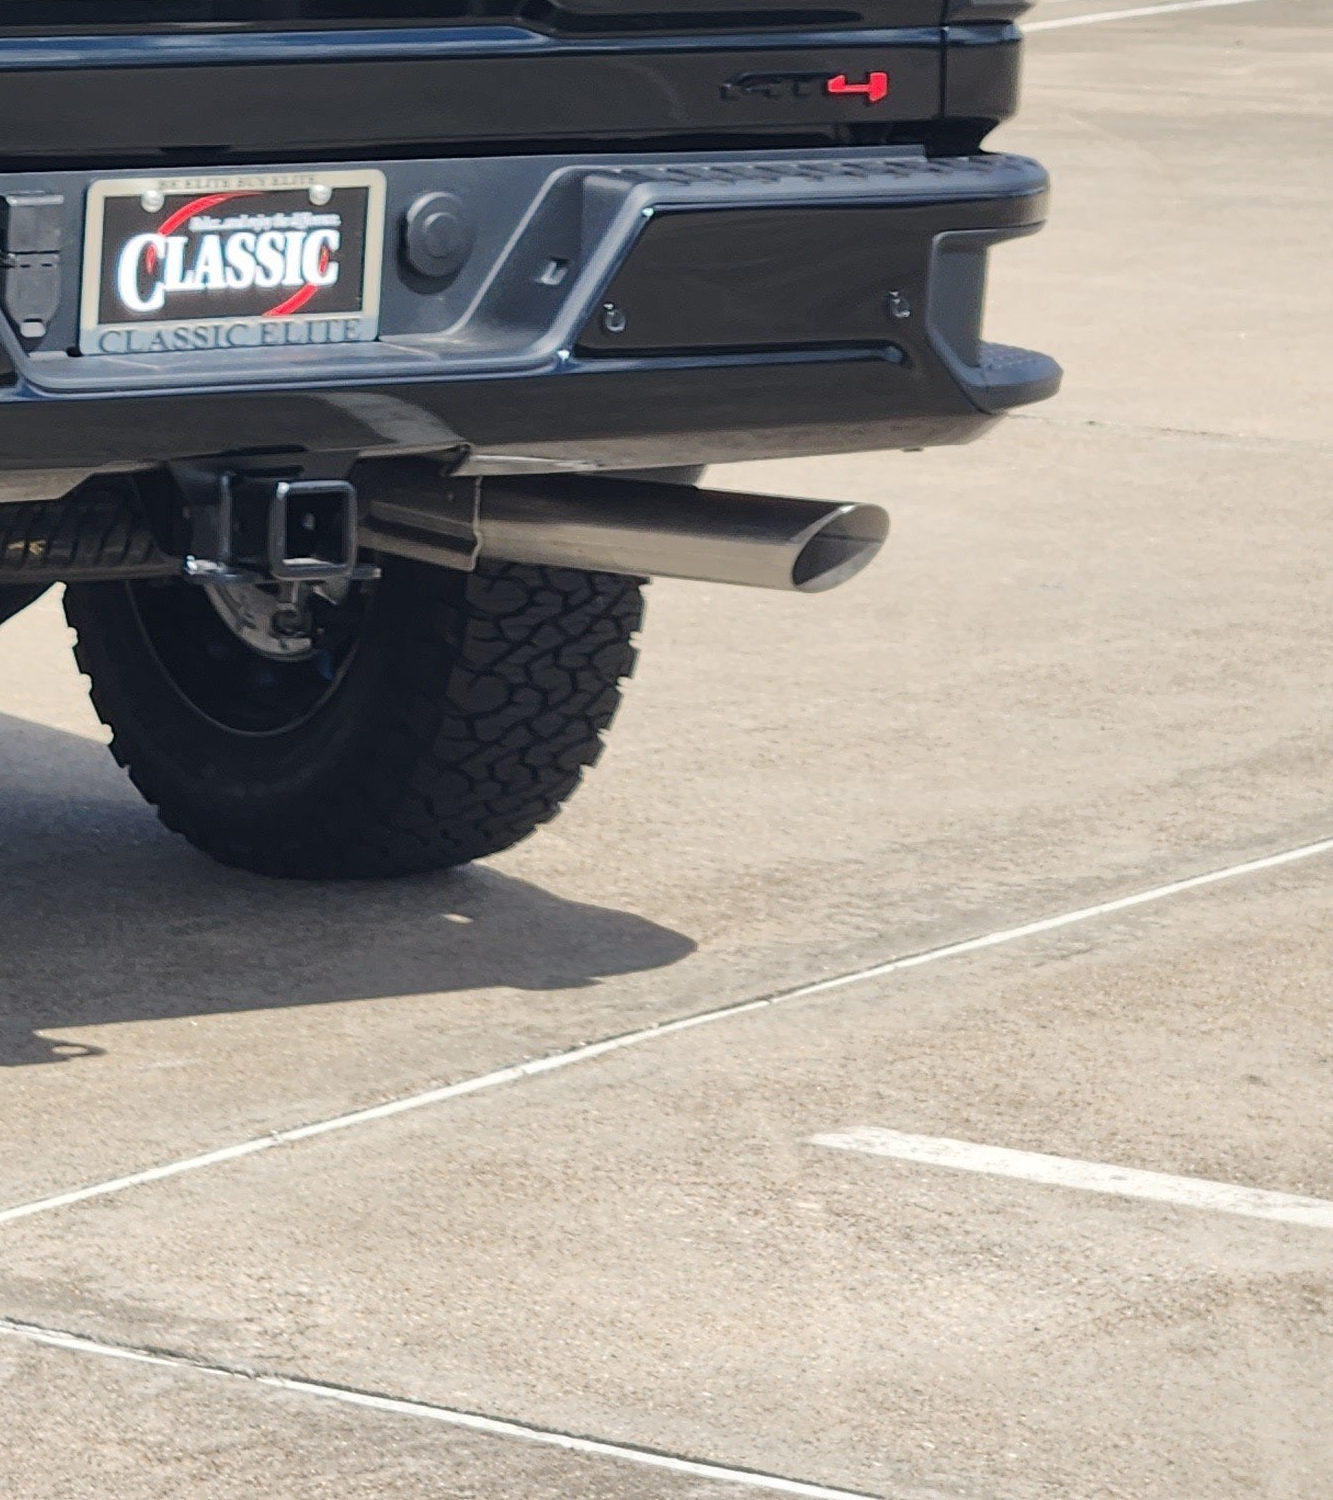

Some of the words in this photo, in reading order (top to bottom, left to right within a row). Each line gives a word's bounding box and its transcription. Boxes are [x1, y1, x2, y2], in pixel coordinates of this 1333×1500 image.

[116, 228, 341, 313] CLASSIC
[98, 325, 249, 354] CLASSIC
[259, 318, 361, 344] ELITE
